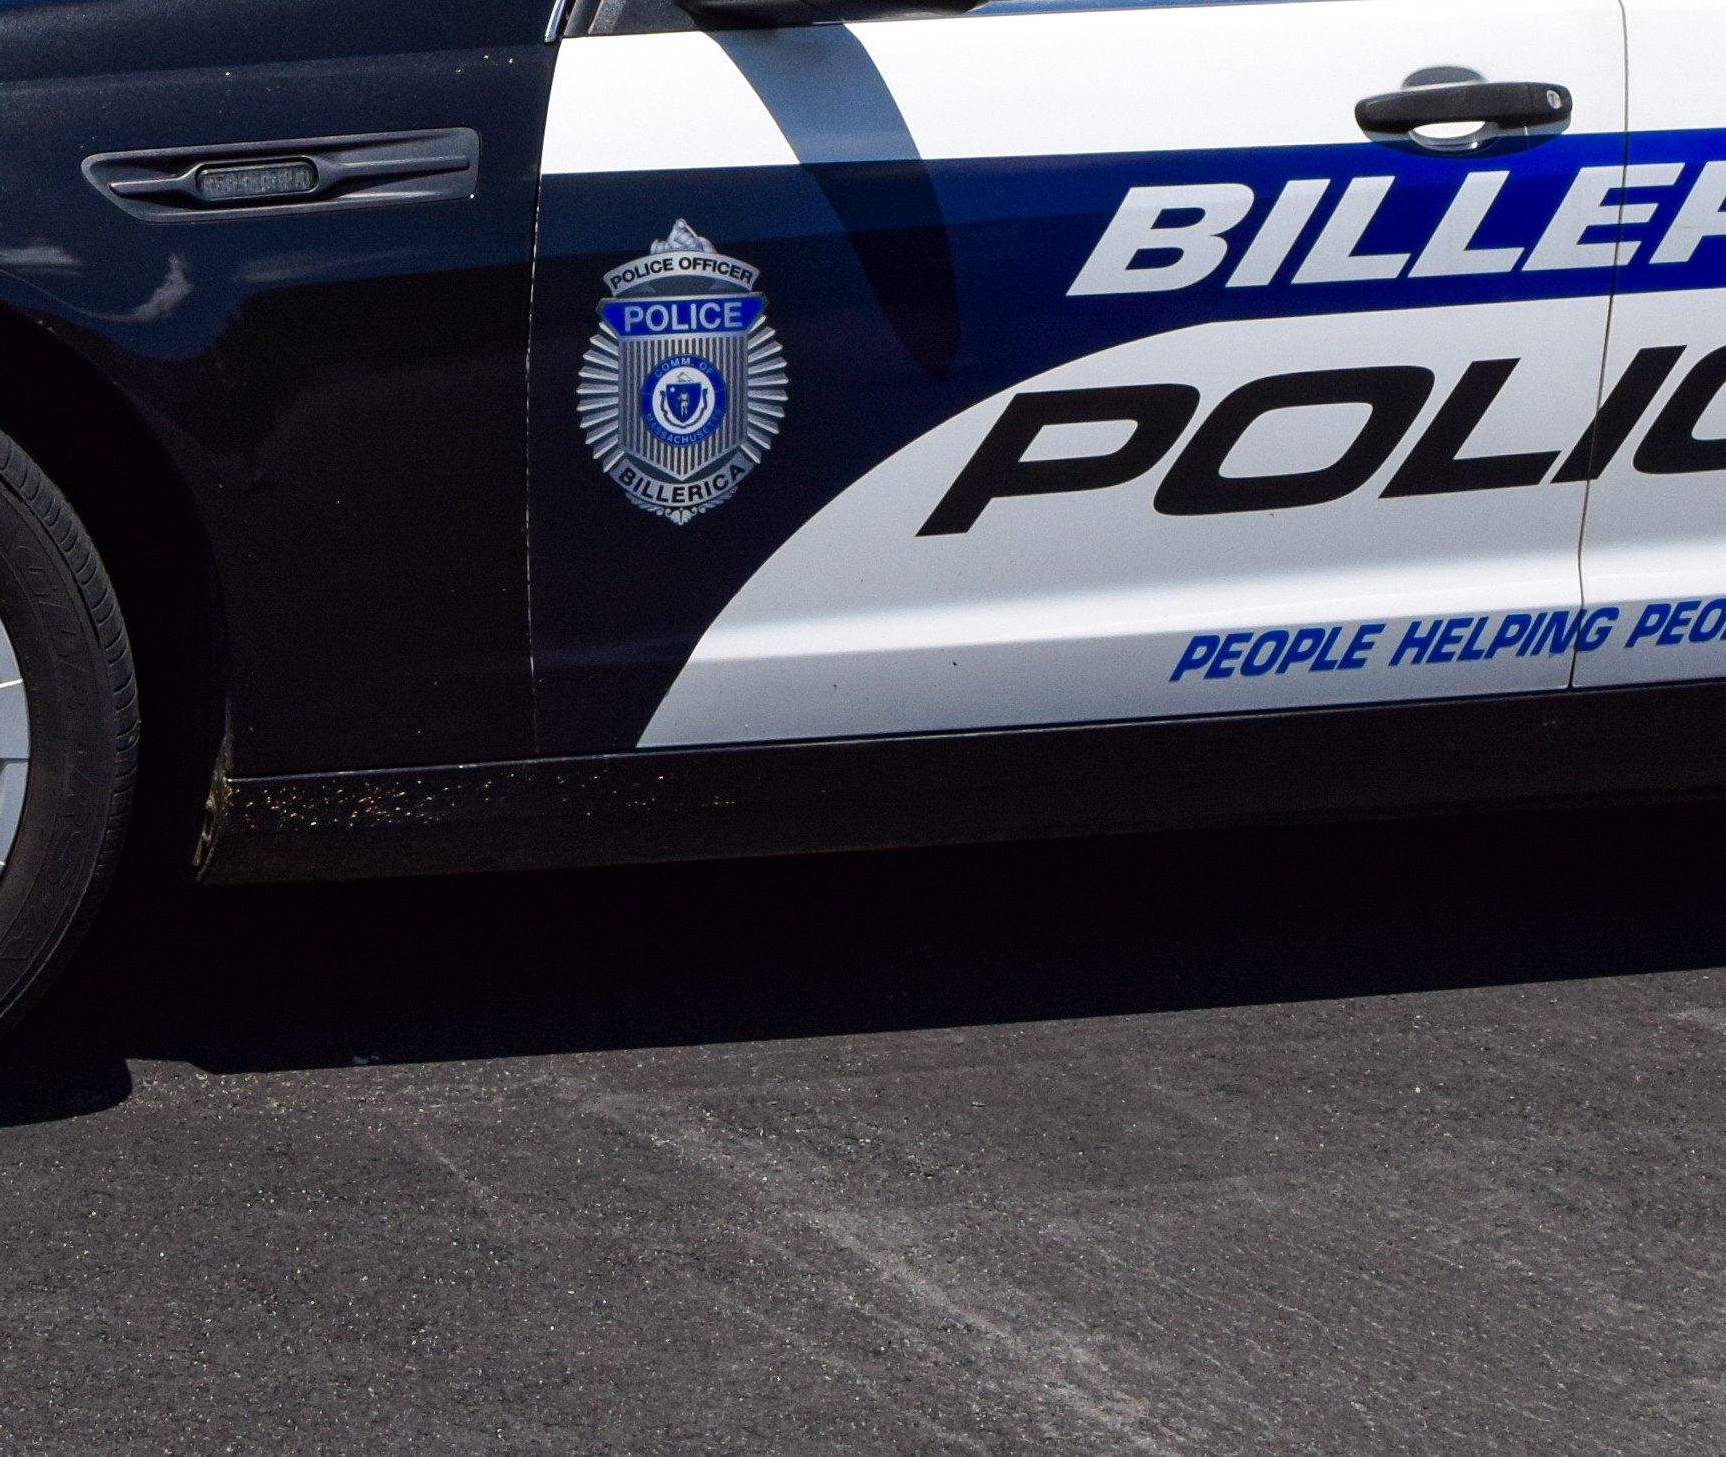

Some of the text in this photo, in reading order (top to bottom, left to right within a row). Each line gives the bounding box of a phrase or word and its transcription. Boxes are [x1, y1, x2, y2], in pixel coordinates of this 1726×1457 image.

[609, 256, 754, 290] POLICE OFFICER
[624, 301, 743, 334] POLICE
[698, 359, 715, 377] OF
[619, 462, 746, 504] BILLERICA
[1168, 622, 1383, 683] PEOPLE
[1393, 606, 1620, 667] HELPING
